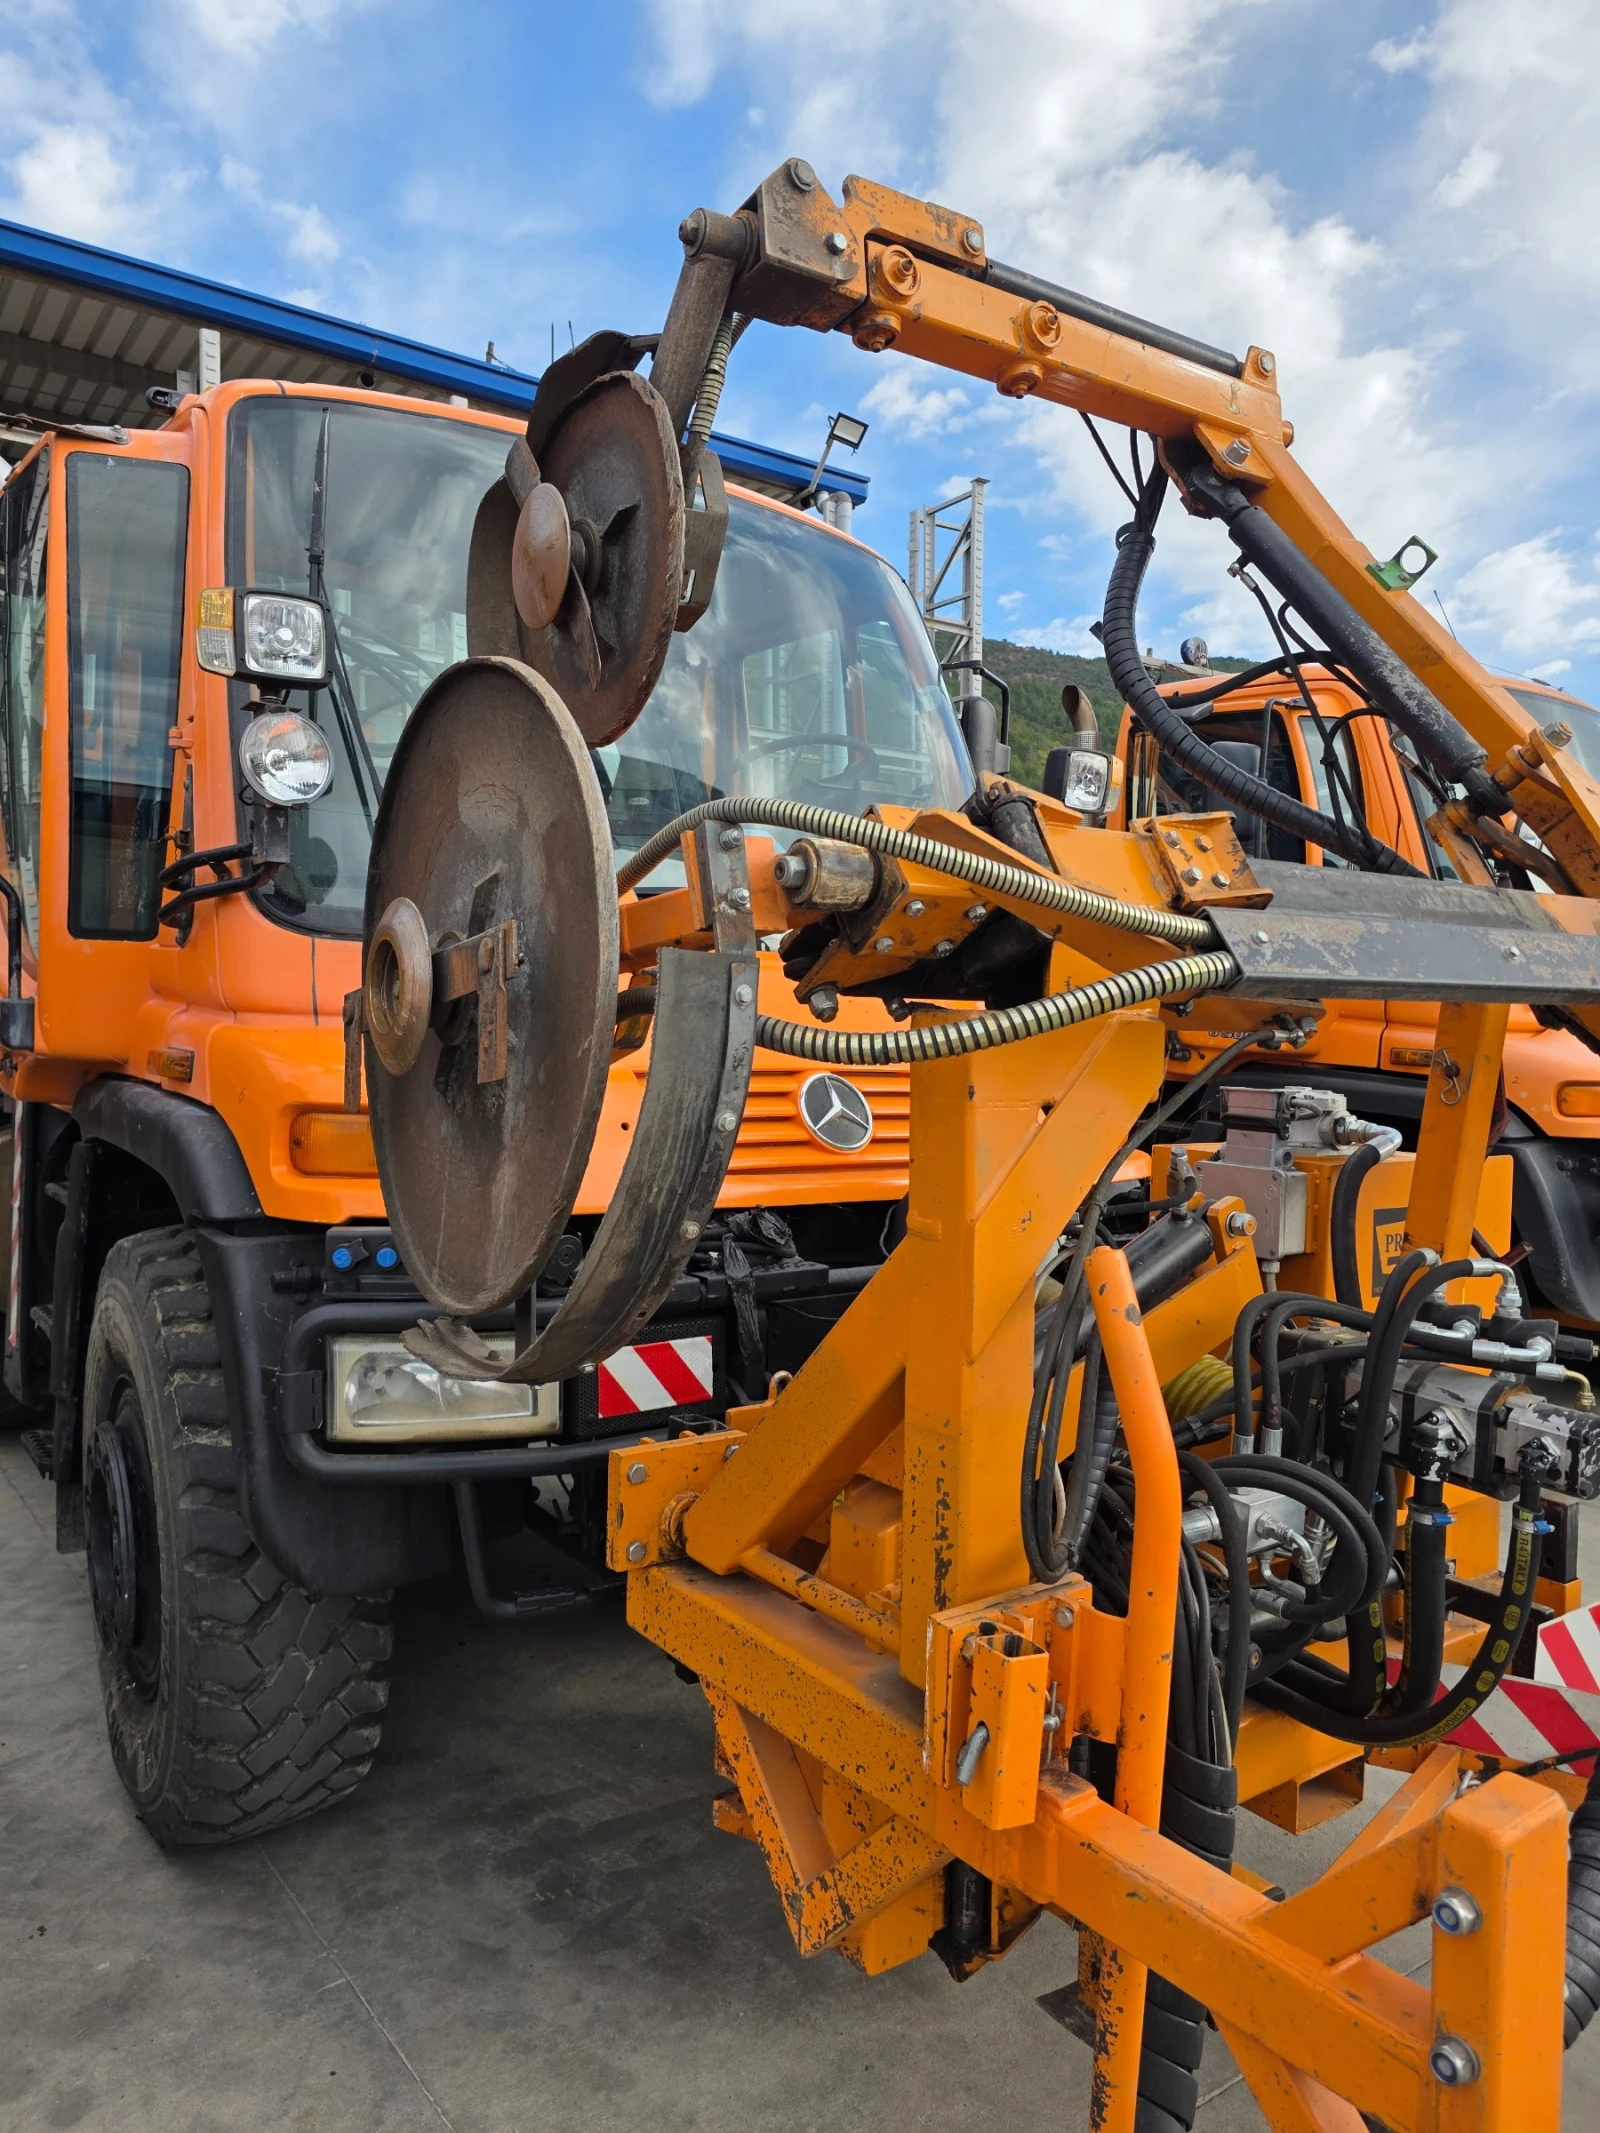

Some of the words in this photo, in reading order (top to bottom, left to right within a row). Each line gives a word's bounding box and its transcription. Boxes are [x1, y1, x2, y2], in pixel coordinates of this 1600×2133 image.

[1385, 1233, 1403, 1253] PR
[1515, 1554, 1529, 1587] ITALY
[1435, 1701, 1472, 1739] PETROFOR
